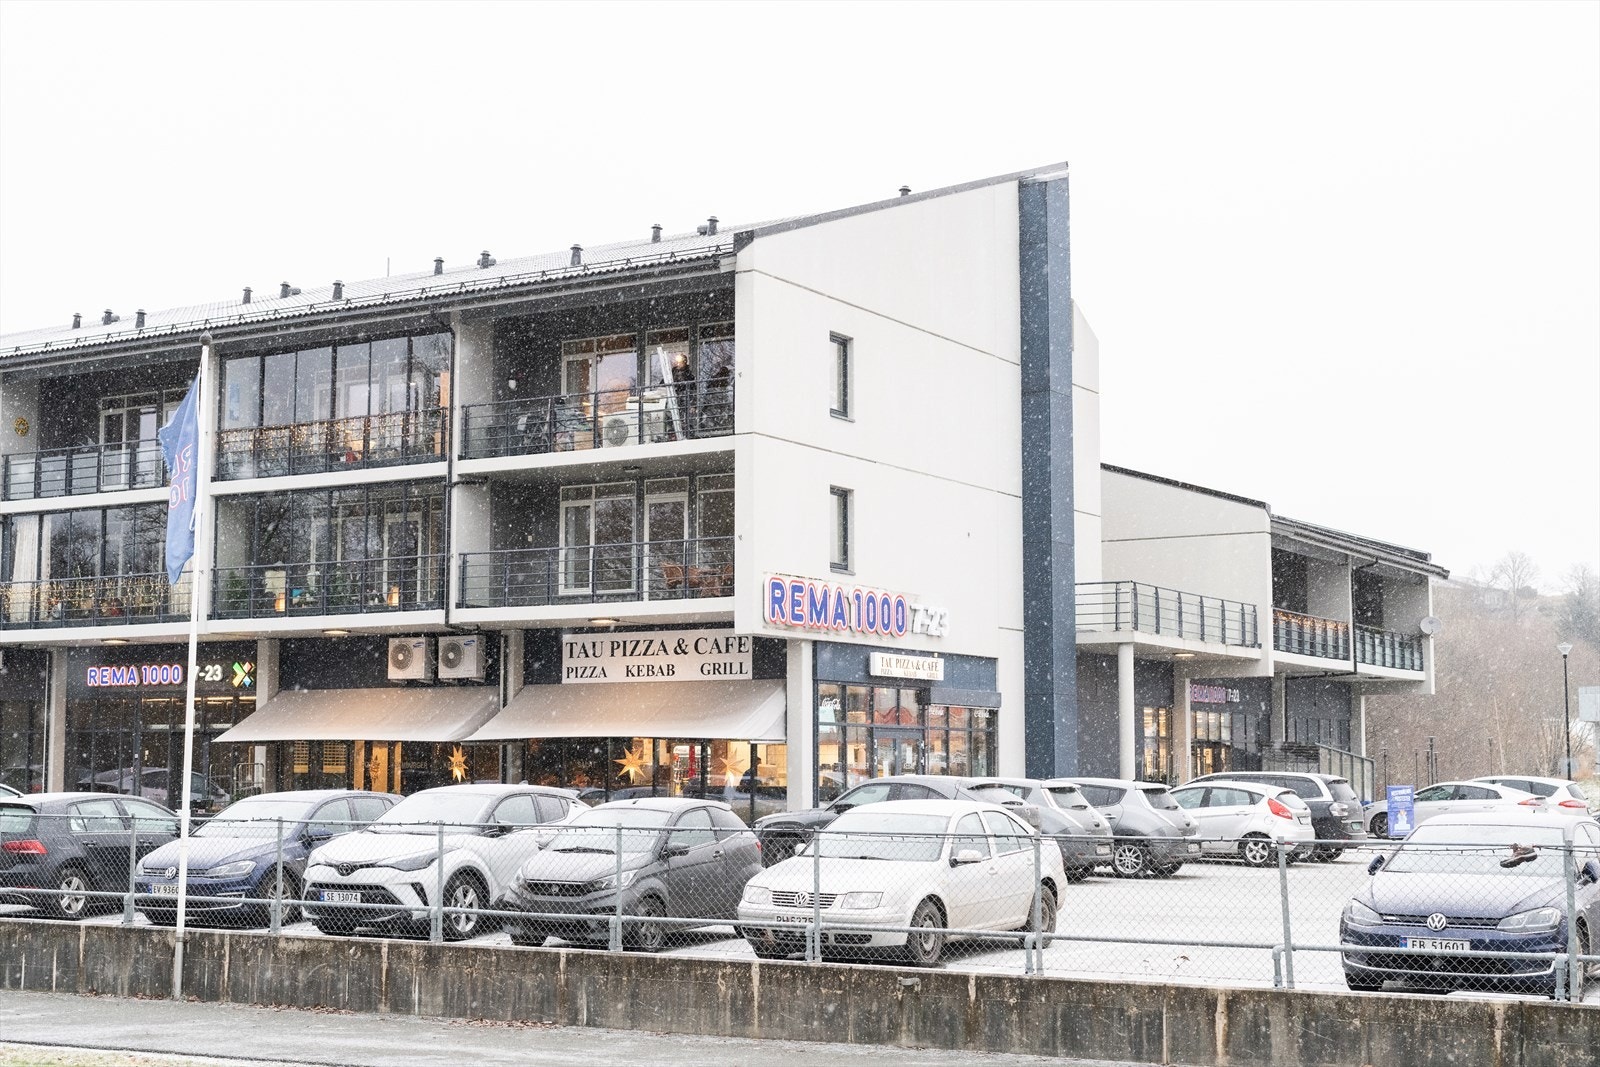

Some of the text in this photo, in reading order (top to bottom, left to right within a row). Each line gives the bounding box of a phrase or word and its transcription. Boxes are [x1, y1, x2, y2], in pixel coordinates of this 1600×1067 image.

[769, 577, 950, 638] REMA 1000 7-23
[565, 640, 603, 659] TAU
[609, 639, 669, 657] PIZZA
[673, 637, 689, 655] &
[566, 661, 748, 679] PIZZA KEBAB GRILL
[881, 656, 893, 668] TAU
[895, 658, 915, 669] PIZZA
[87, 666, 138, 686] REMA
[142, 664, 183, 685] 1000
[153, 885, 179, 895] EV 9360
[326, 892, 358, 902] SE 13074
[1431, 941, 1465, 951] 51601
